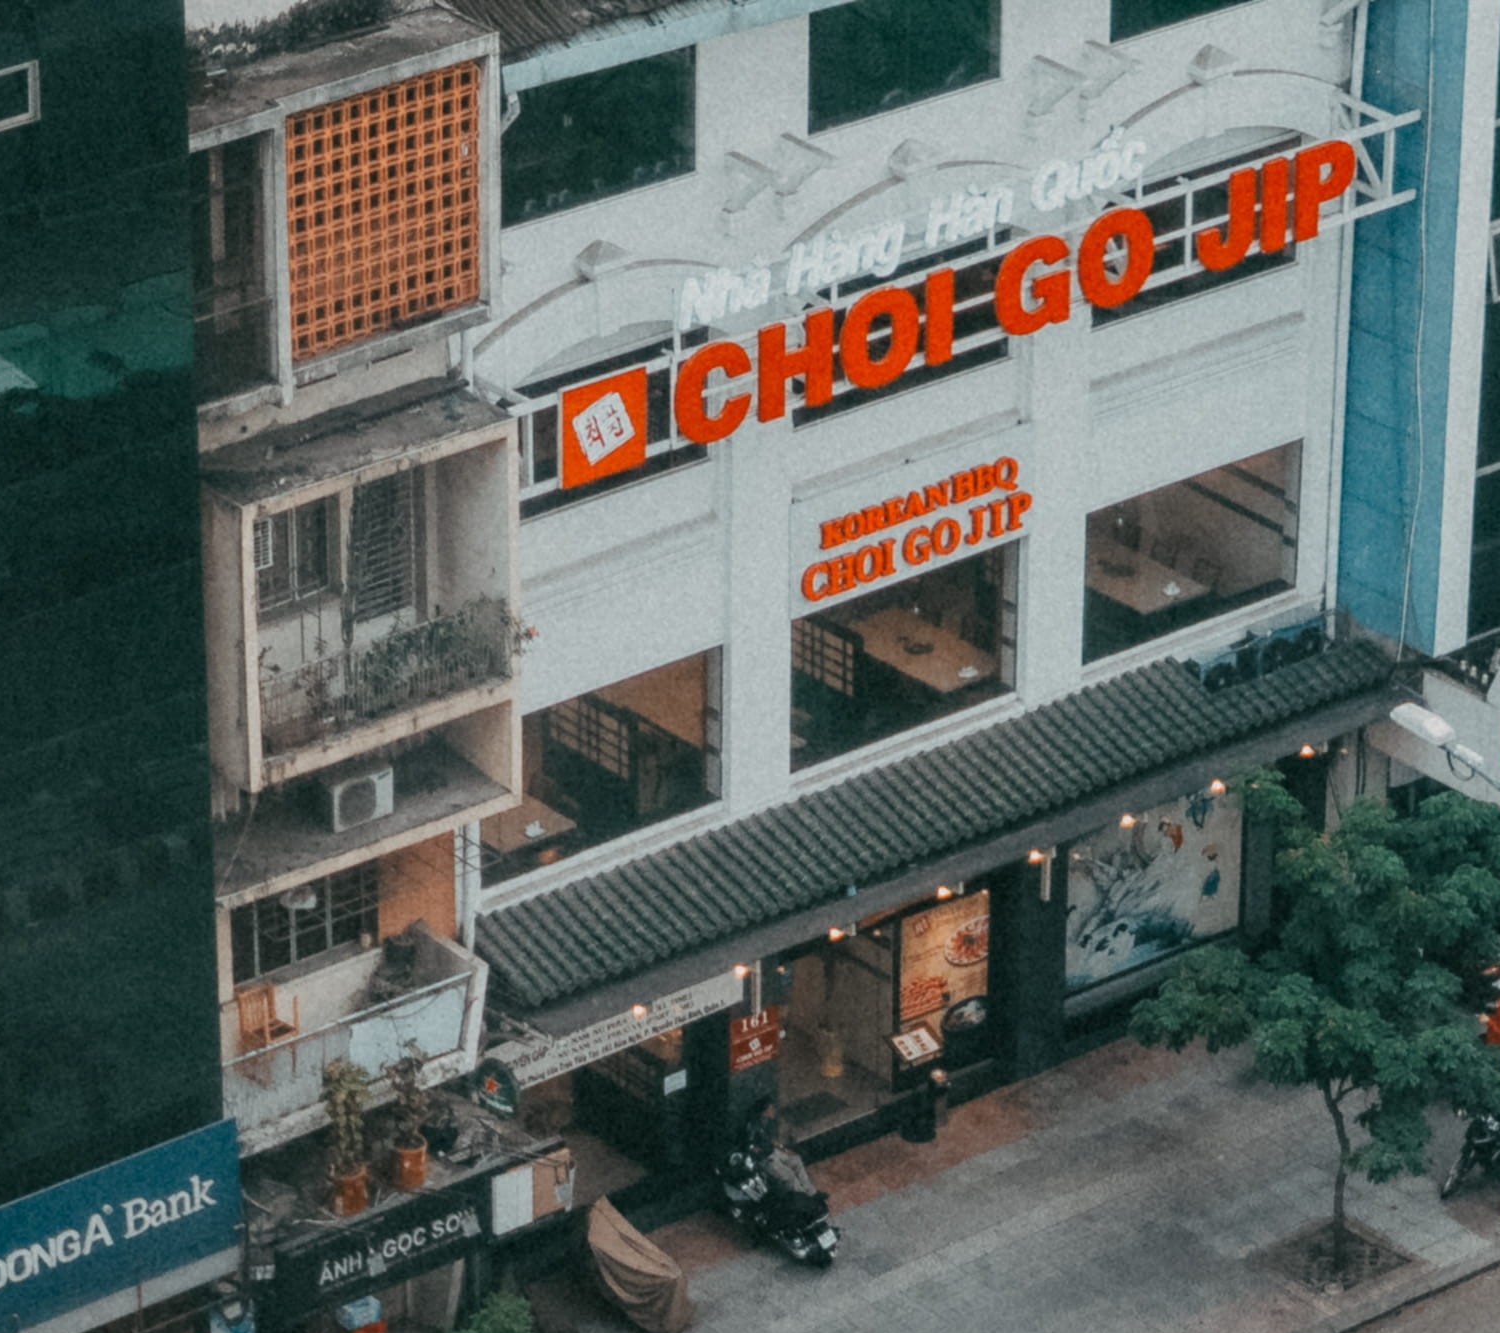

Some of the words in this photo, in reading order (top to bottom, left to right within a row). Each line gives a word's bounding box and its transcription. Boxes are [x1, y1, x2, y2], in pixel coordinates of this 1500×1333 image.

[786, 222, 905, 295] Hàng
[925, 184, 1013, 248] Hàn
[674, 267, 955, 444] CHOI
[994, 207, 1155, 335] GO
[1196, 140, 1357, 272] JIP
[801, 537, 896, 601] CHOI
[902, 517, 961, 565] GO
[965, 492, 1032, 545] JIP
[819, 480, 949, 550] KOREAN
[951, 456, 1018, 503] BBQ
[742, 1011, 768, 1032] 161
[121, 1173, 217, 1240] Bank
[319, 1251, 363, 1286] ÁNH
